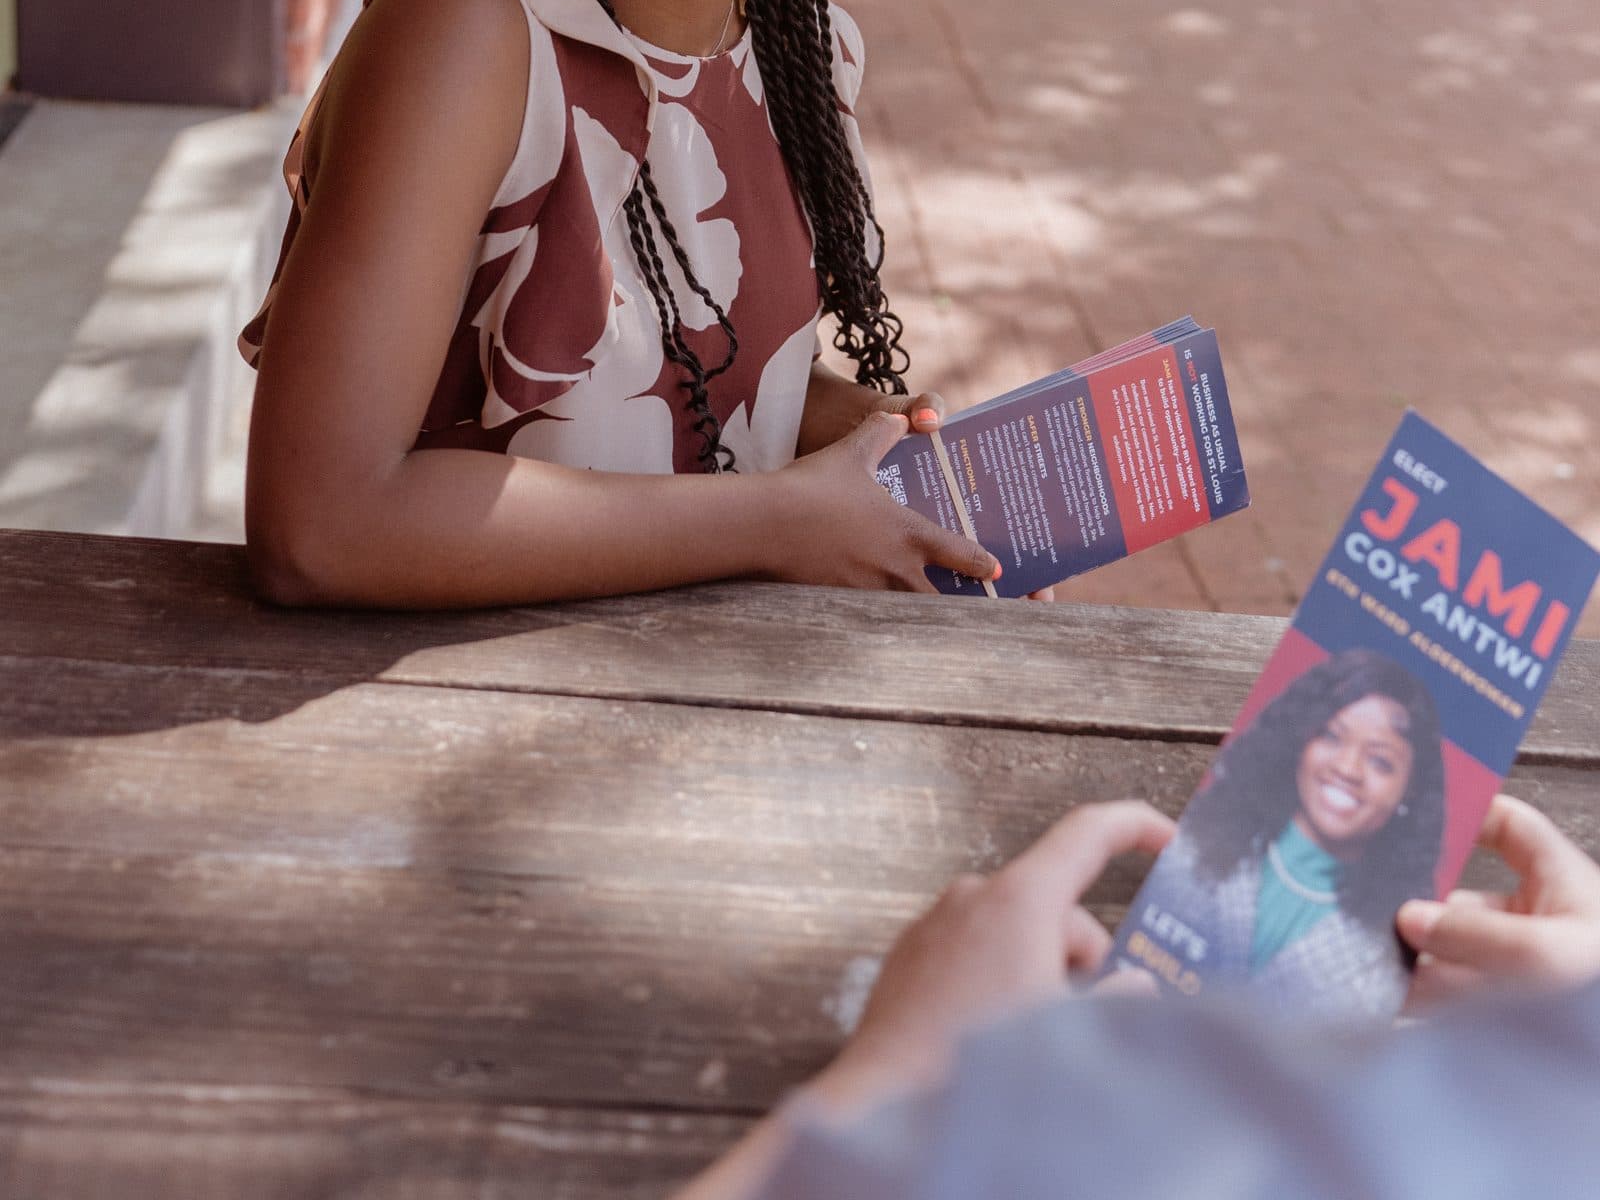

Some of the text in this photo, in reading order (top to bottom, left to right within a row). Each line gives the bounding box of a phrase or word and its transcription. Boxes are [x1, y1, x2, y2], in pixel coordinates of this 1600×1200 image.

[1156, 377, 1165, 387] to
[1124, 401, 1132, 414] the
[1130, 382, 1142, 415] challenges
[1158, 386, 1170, 409] build
[1018, 417, 1026, 431] You
[1042, 408, 1053, 429] where
[1071, 414, 1079, 427] has
[1115, 404, 1126, 430] running
[1127, 413, 1135, 426] last
[1137, 414, 1145, 427] our
[1183, 348, 1223, 504] IS NOT WORKING FOR ST. LOUIS
[1199, 372, 1227, 473] BUSINESS AS USUAL
[975, 432, 983, 445] not
[1009, 420, 1020, 443] causes
[1047, 429, 1058, 454] families
[1074, 426, 1083, 443] used
[1120, 429, 1128, 440] for
[1130, 425, 1141, 449] decade
[1161, 357, 1201, 512] JAMI has the vision the 8th Ward needs
[949, 441, 957, 453] No
[984, 429, 999, 471] enforcement
[1001, 423, 1017, 467] disinvestment
[1026, 414, 1048, 479] SAFER STREETS
[1078, 442, 1089, 468] creative
[1111, 434, 1123, 464] solutions
[1140, 426, 1154, 467] communities
[1143, 394, 1151, 408] and
[1150, 426, 1157, 434] in
[1161, 477, 1171, 499] knows
[1166, 498, 1174, 510] the
[913, 453, 922, 467] just
[922, 450, 933, 473] pickup
[952, 452, 962, 470] more
[978, 444, 989, 468] against
[1025, 446, 1035, 469] reduce
[1053, 453, 1061, 466] can
[1076, 396, 1110, 516] STRONGER NEIGHBORHOODS
[1123, 439, 1137, 479] alderwoman
[927, 472, 937, 487] and
[958, 438, 978, 493] FUNCTIONAL
[972, 492, 983, 513] CITY
[994, 469, 1003, 484] that
[1012, 466, 1021, 484] drive
[1030, 468, 1040, 488] crime
[1051, 405, 1090, 548] will transform neglected properties into spaces
[1056, 465, 1065, 483] grow
[1059, 402, 1073, 438] community
[1079, 488, 1088, 502] and
[1089, 528, 1098, 541] She
[1393, 449, 1448, 494] ELECT
[931, 485, 940, 500] 911
[1020, 464, 1035, 505] understands
[1060, 482, 1069, 496] and
[1132, 478, 1139, 487] to
[997, 483, 1007, 504] works
[1006, 482, 1019, 514] strategies
[1034, 487, 1046, 513] without
[1090, 496, 1098, 505] to
[1134, 486, 1143, 504] bring
[1002, 503, 1011, 519] with
[1013, 512, 1022, 527] and
[1029, 504, 1038, 518] that
[1092, 504, 1101, 520] help
[1005, 518, 1014, 531] the
[1033, 517, 1042, 538] decay
[1040, 512, 1054, 547] addressing
[1096, 519, 1105, 536] build
[1017, 526, 1028, 552] smarter
[1027, 530, 1036, 547] push
[1037, 536, 1046, 550] and
[1031, 546, 1039, 558] for
[1048, 546, 1058, 564] what
[1360, 476, 1571, 660] JAMI
[1345, 532, 1543, 690] COX ANTWI
